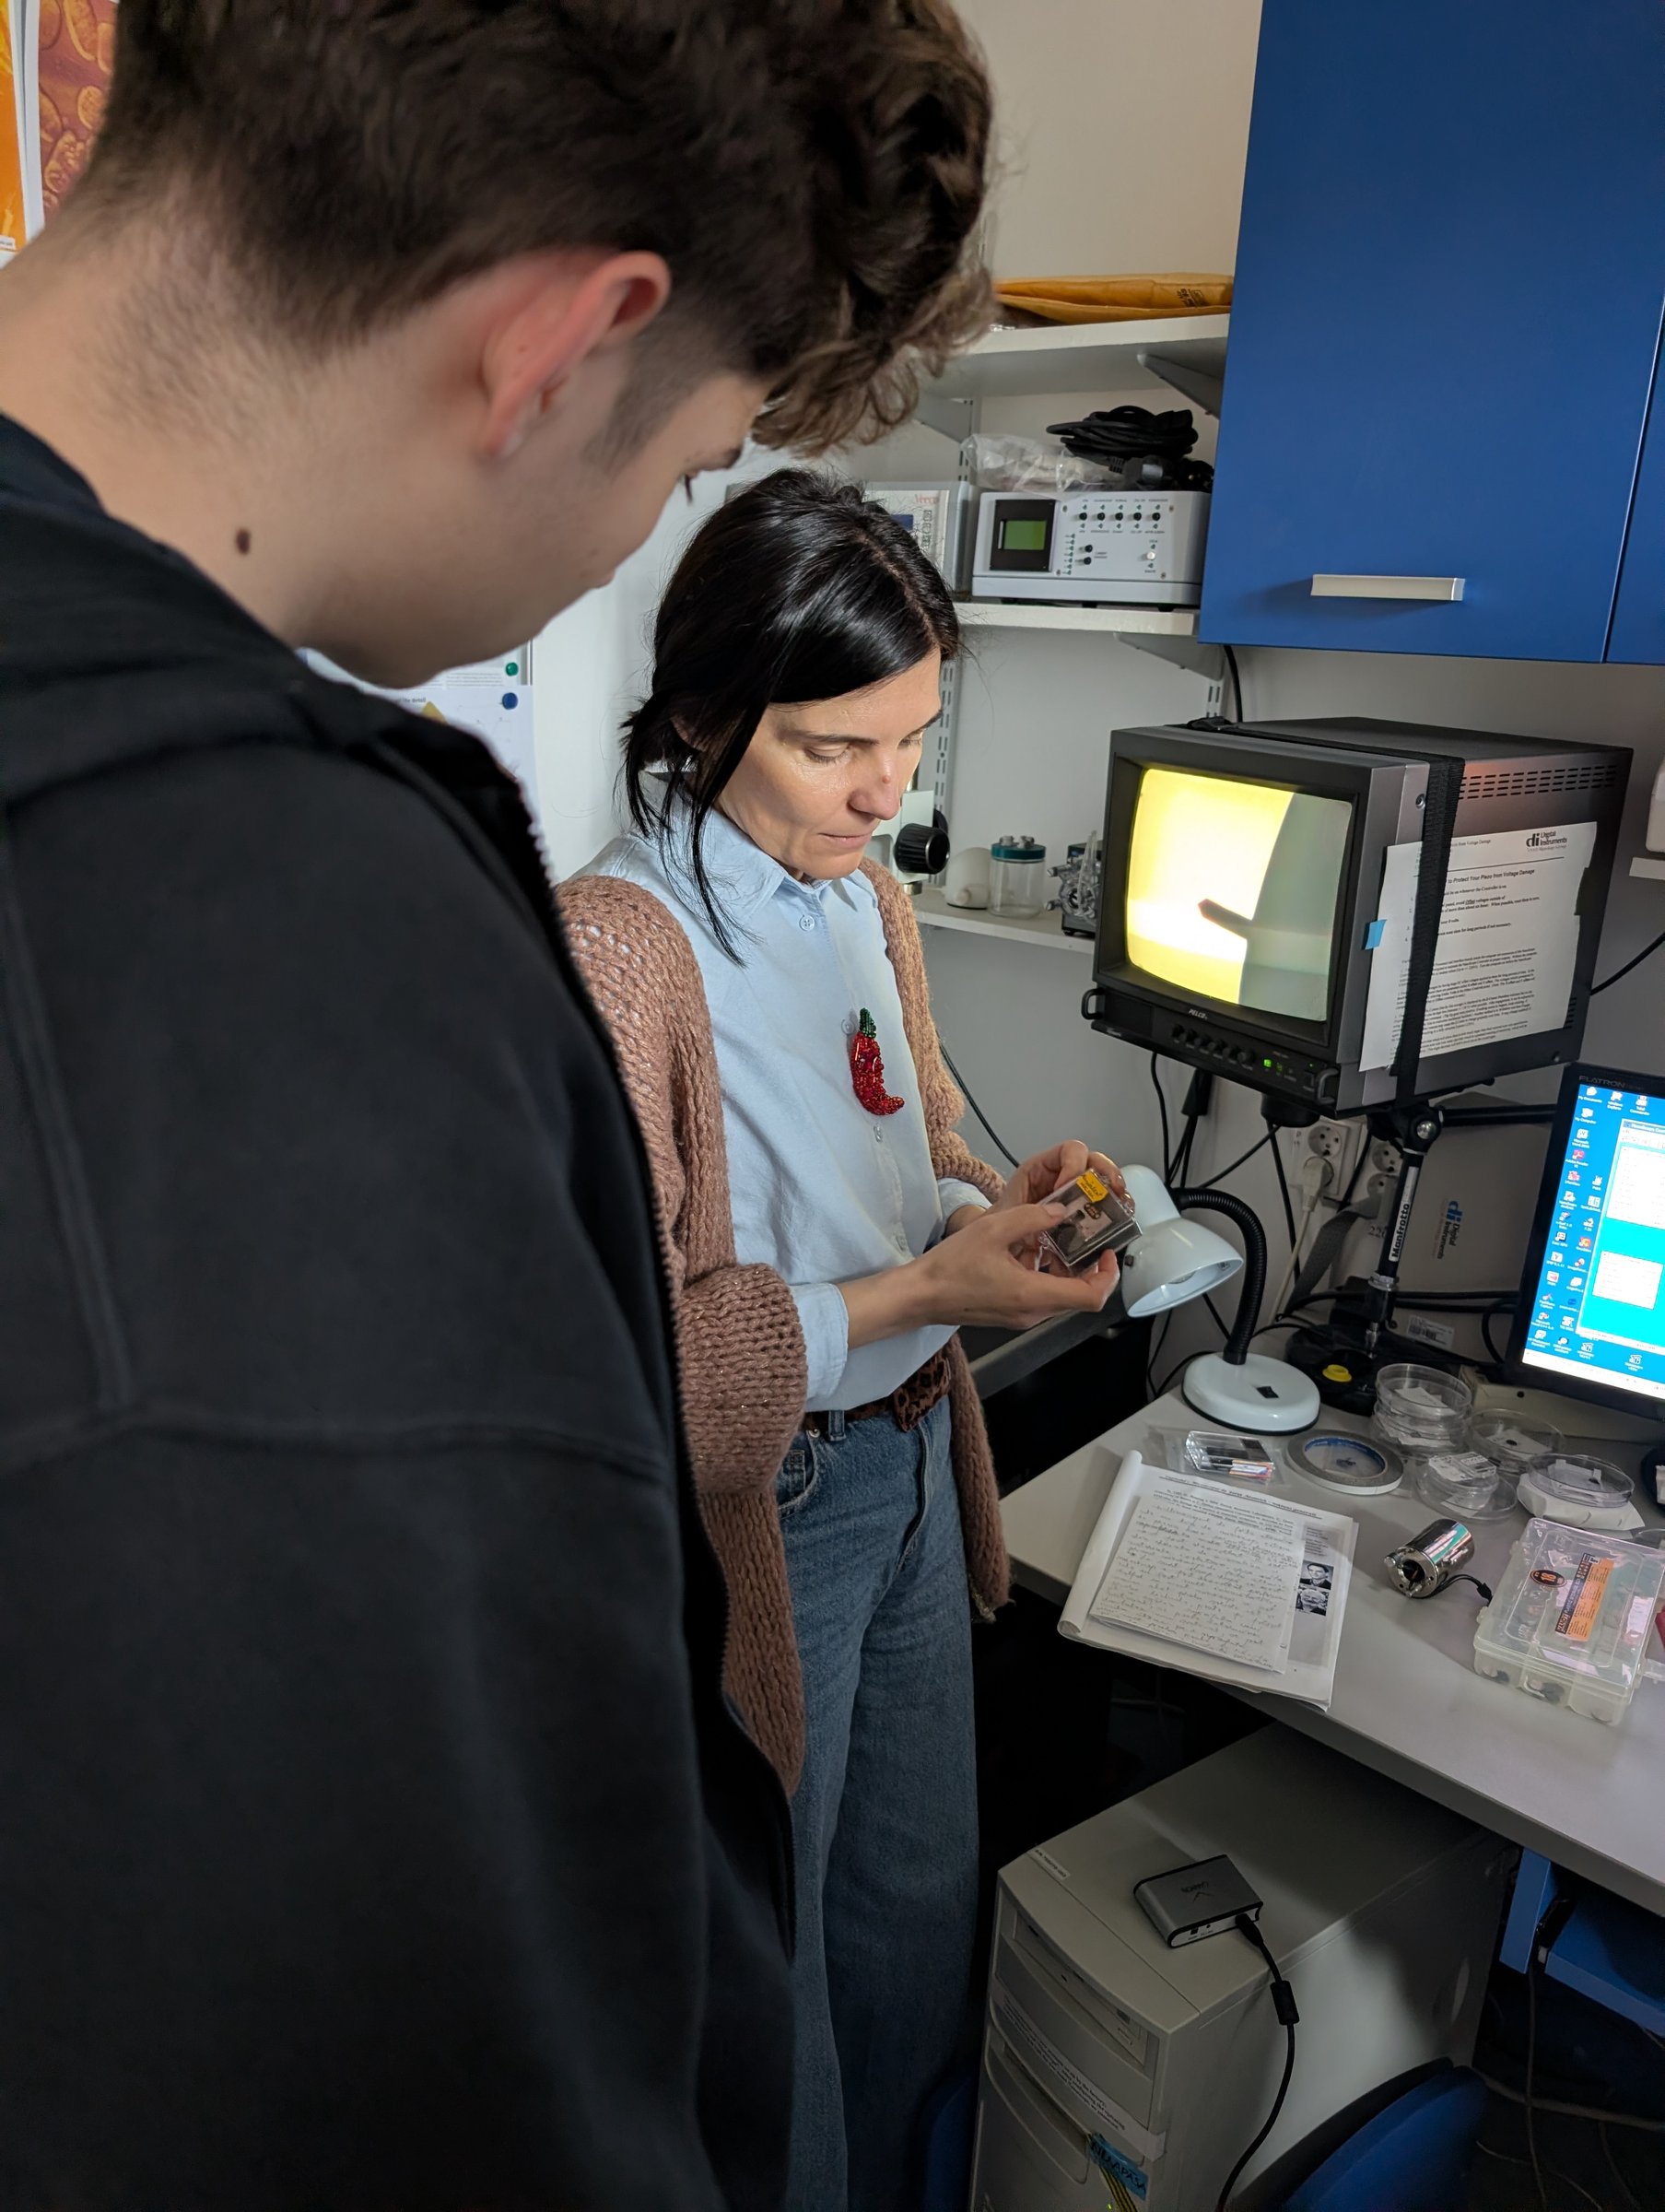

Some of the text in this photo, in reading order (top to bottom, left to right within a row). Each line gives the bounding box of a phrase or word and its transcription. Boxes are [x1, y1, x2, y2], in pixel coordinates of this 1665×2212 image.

[1189, 1008, 1206, 1018] PELCO
[1579, 1076, 1625, 1088] FLATRON
[1391, 1204, 1410, 1257] Manfrotto
[1437, 1221, 1450, 1259] Instruments
[1448, 1223, 1460, 1246] Digital
